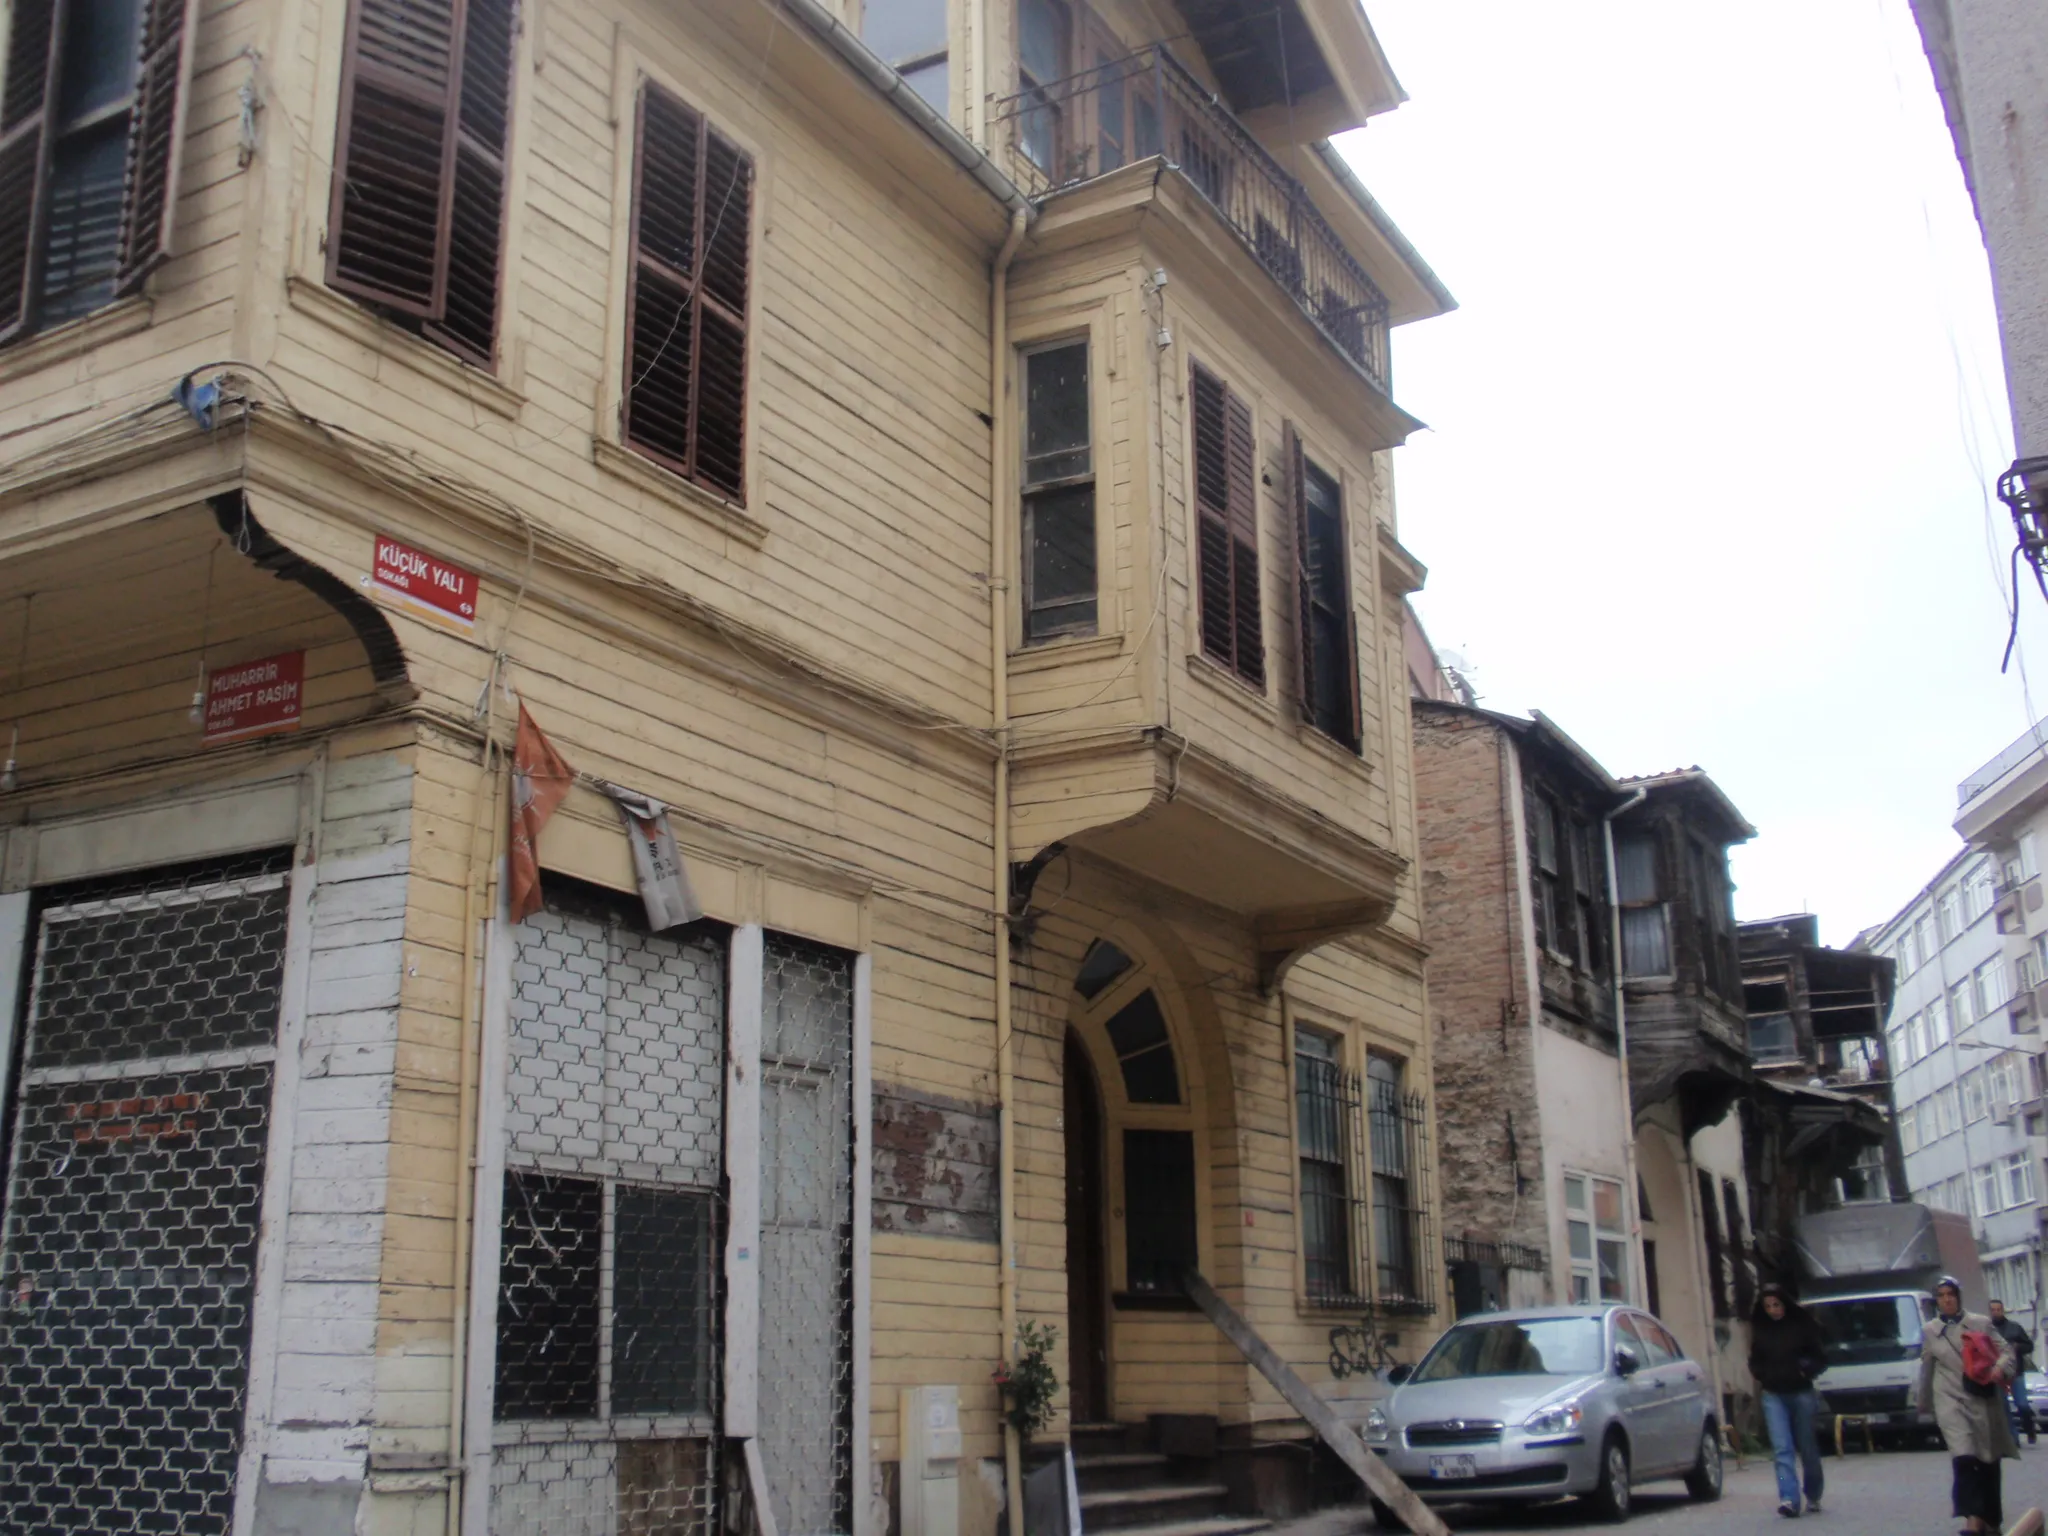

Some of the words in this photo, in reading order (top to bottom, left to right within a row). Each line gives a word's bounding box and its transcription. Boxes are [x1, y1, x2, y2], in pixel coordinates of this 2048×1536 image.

[377, 568, 409, 588] SOKAĞI
[379, 544, 428, 579] KÜÇÜK
[432, 566, 464, 594] YALI
[212, 663, 278, 693] MUHARRİR
[209, 693, 253, 716] AHMET
[256, 681, 298, 705] RASİM
